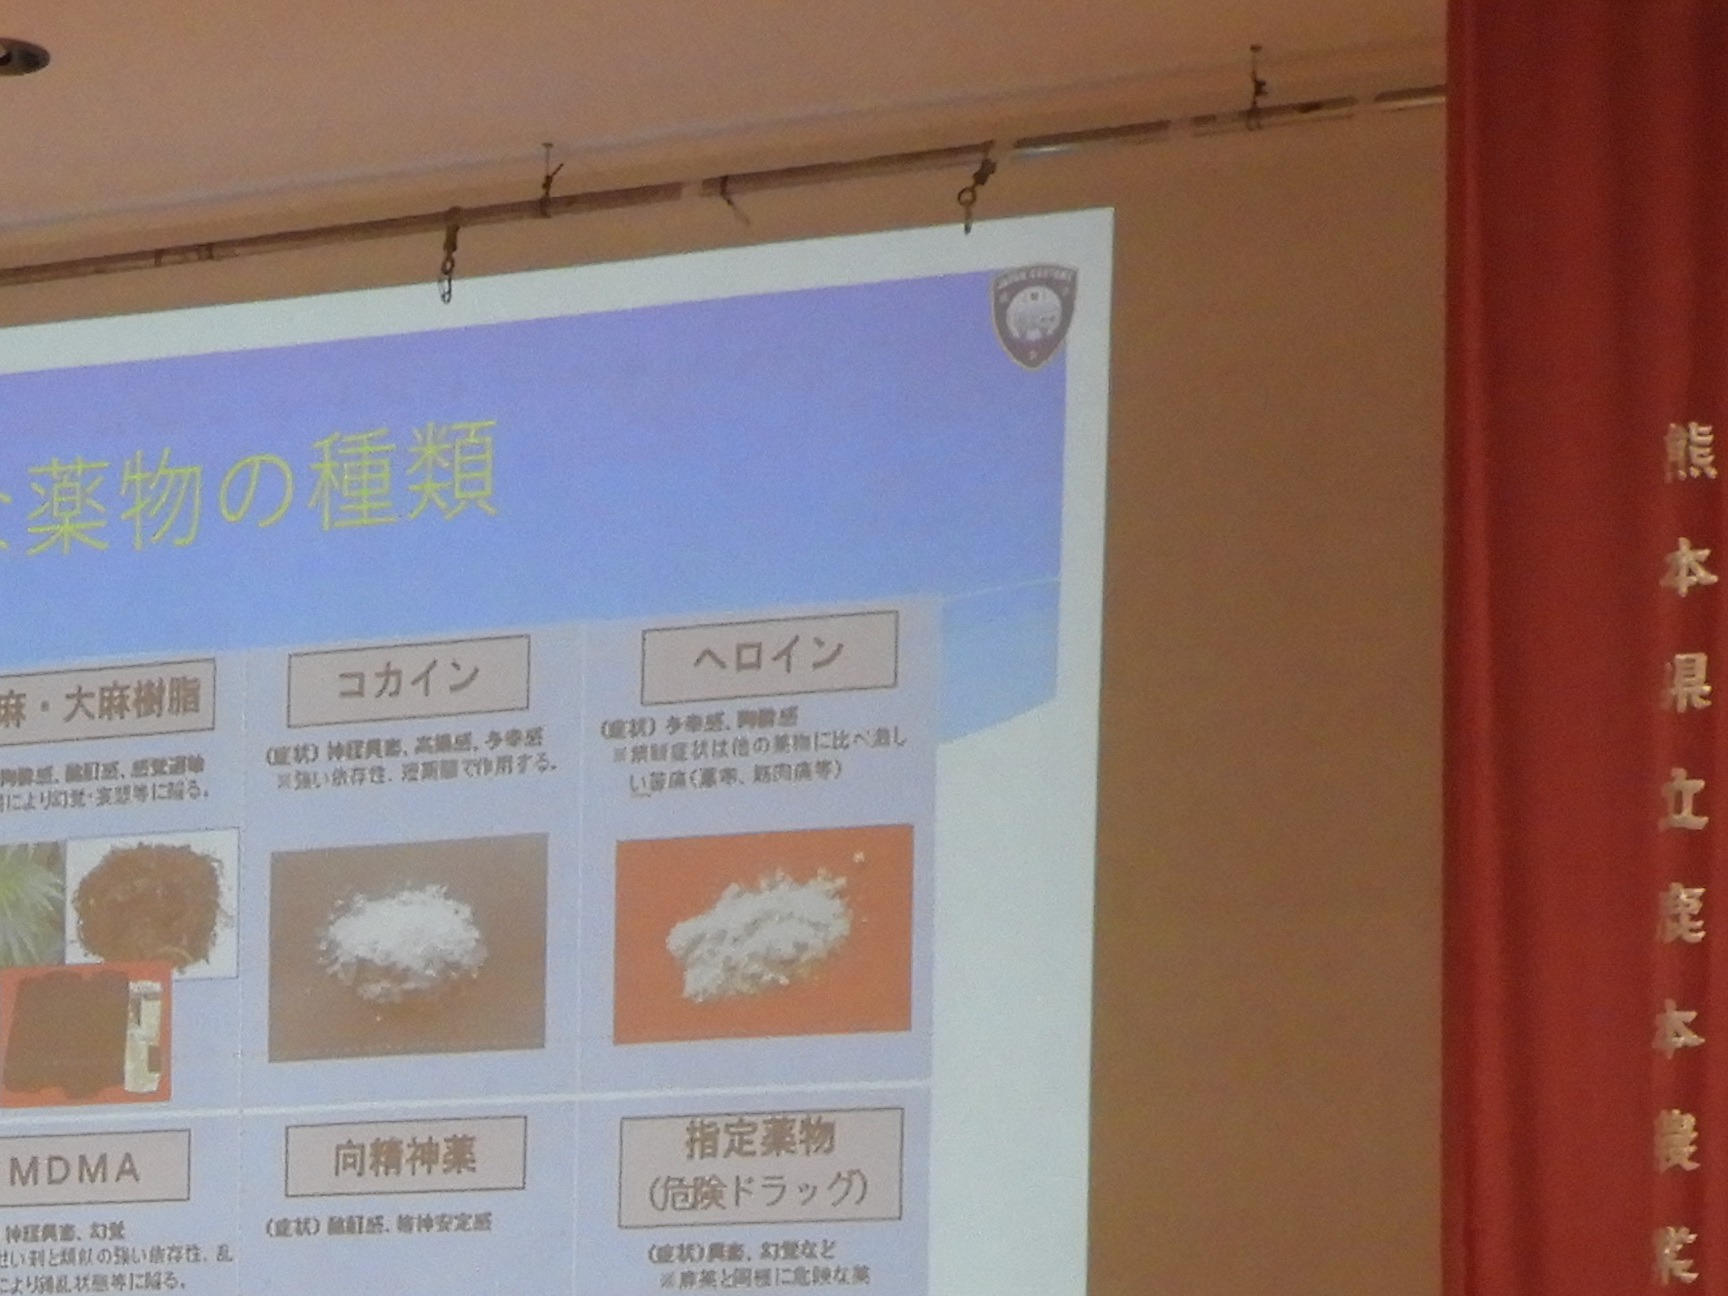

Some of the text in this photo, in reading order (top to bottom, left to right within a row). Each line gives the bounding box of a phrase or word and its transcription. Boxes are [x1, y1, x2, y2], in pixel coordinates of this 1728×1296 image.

[694, 634, 845, 673] ヘロイン
[337, 657, 480, 700] コカイン
[334, 1134, 477, 1178] 向精神薬
[685, 1115, 837, 1161] 指定薬物
[9, 1152, 141, 1187] MDMA
[648, 1168, 869, 1213] (危険ドラッグ)
